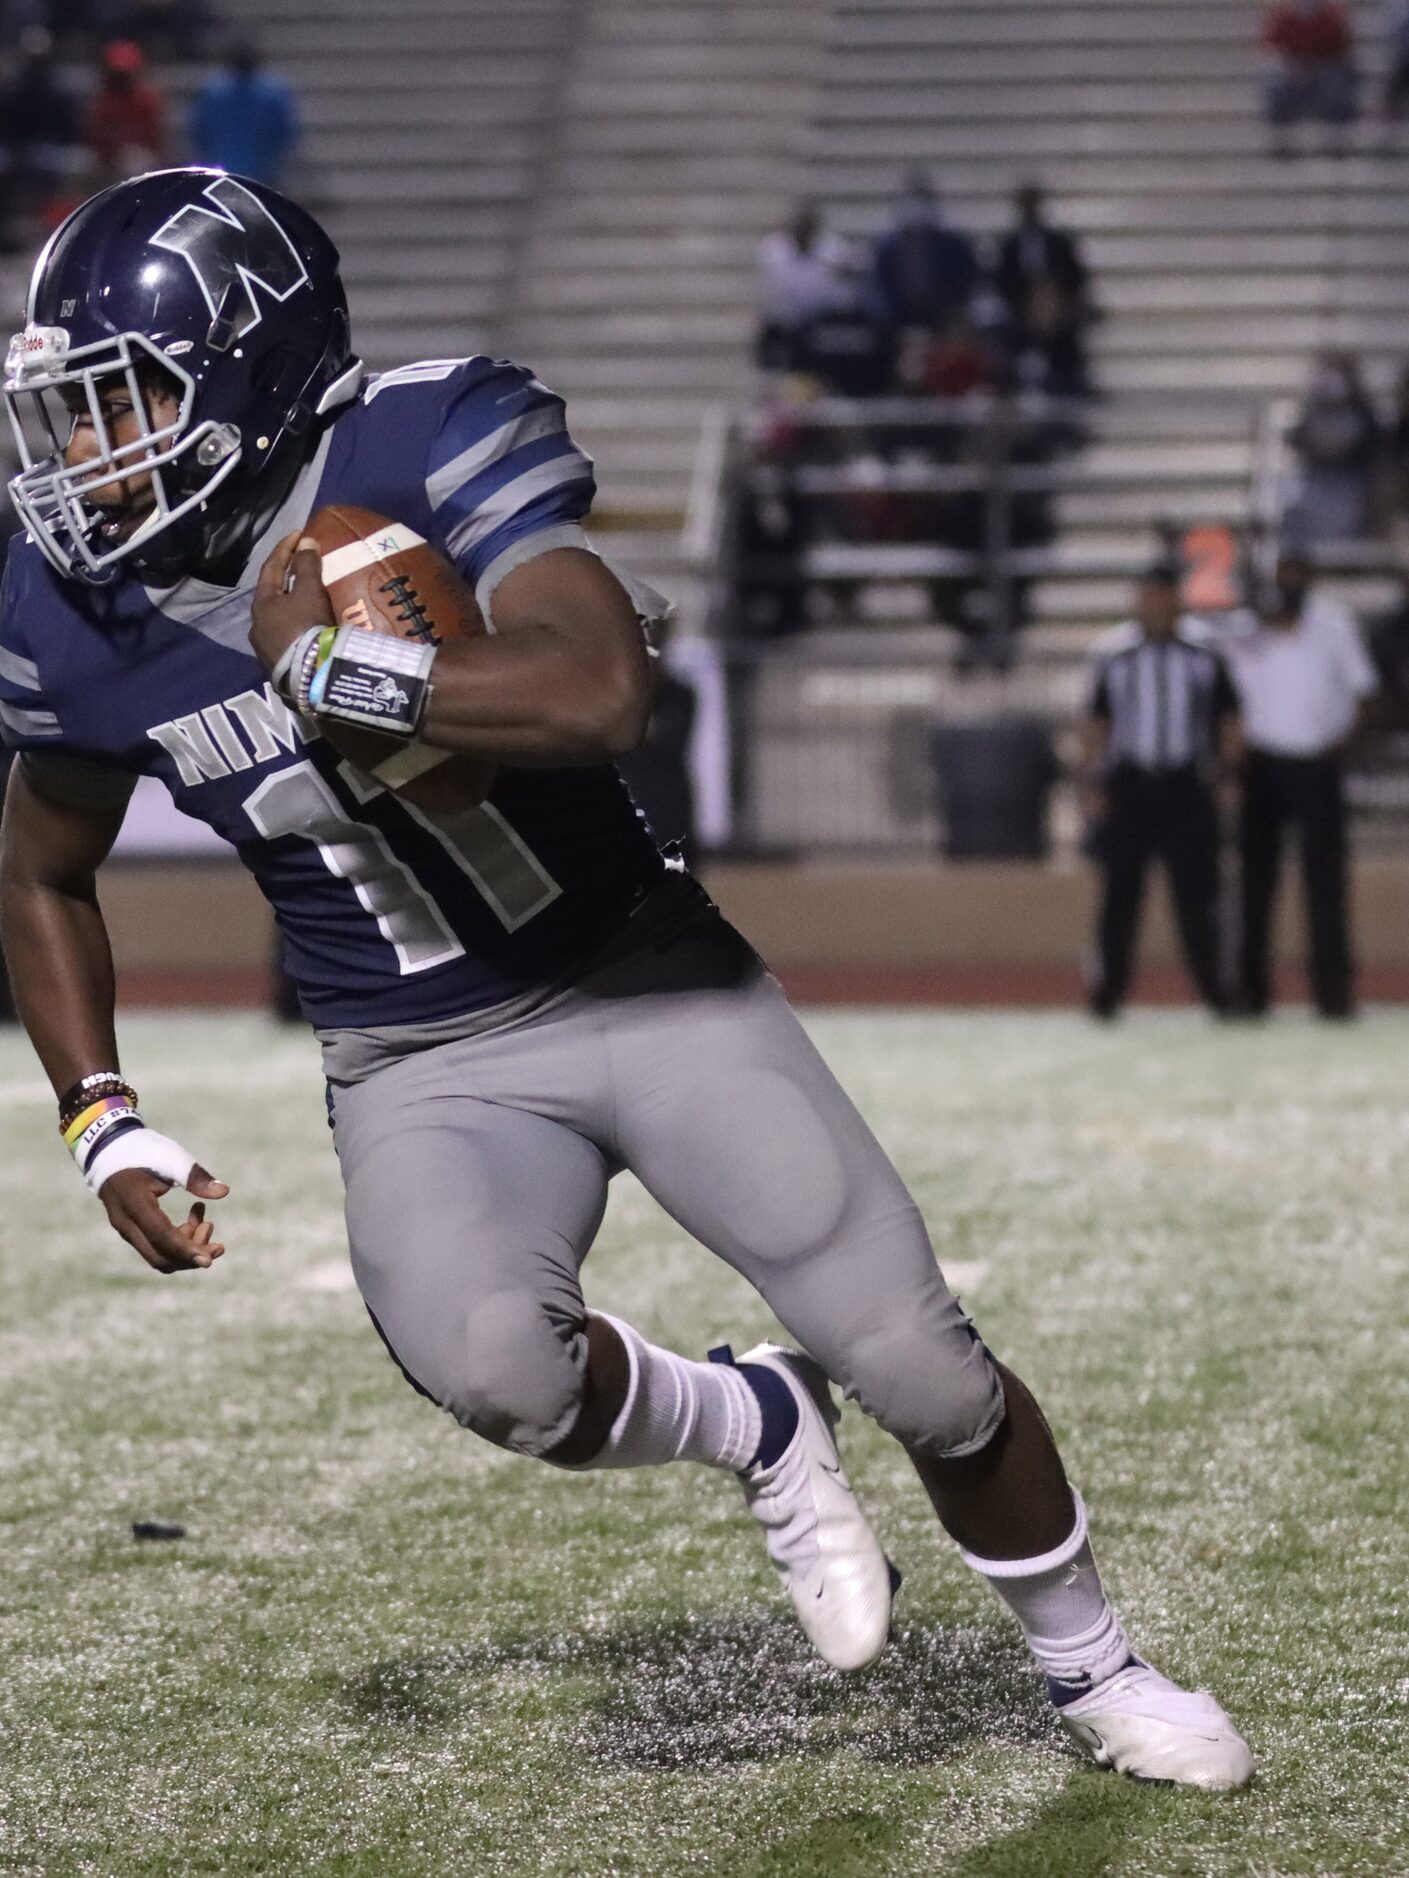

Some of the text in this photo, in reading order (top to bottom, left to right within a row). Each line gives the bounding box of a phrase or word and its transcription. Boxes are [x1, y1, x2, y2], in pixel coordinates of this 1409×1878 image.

[60, 299, 77, 317] N
[148, 177, 310, 339] N
[242, 759, 564, 976] 11
